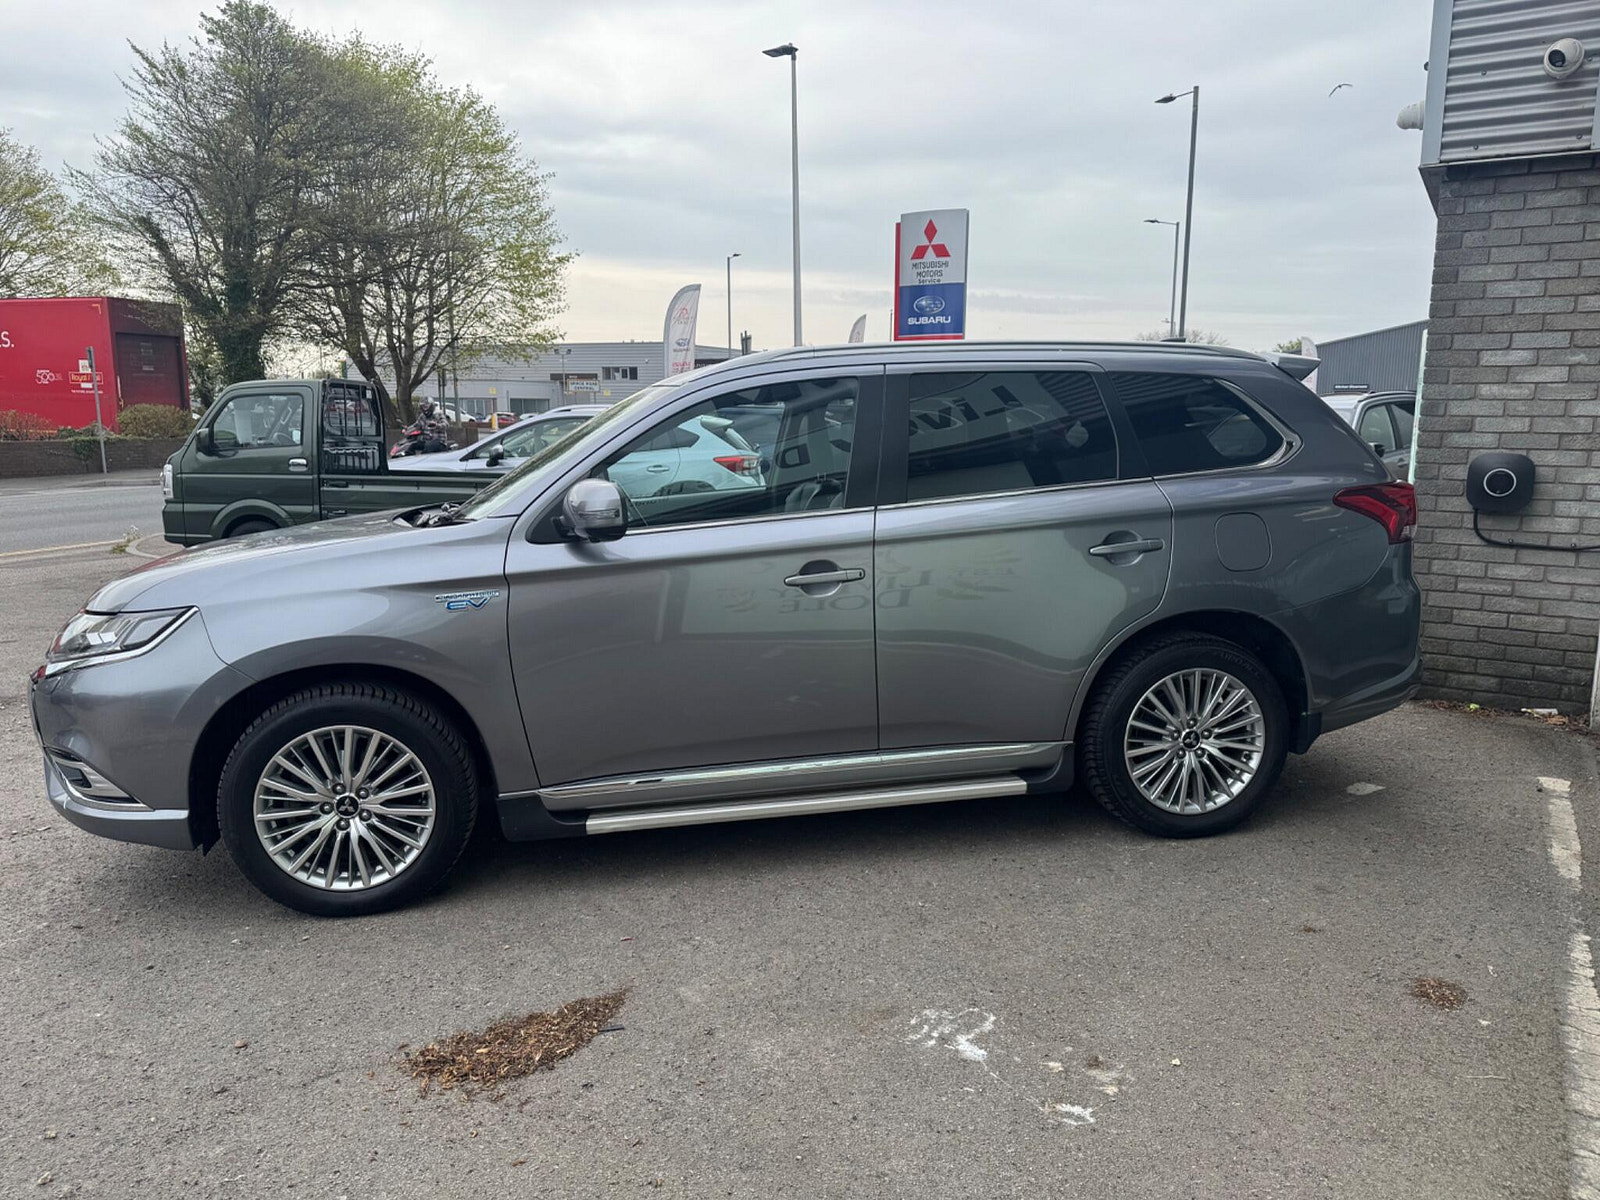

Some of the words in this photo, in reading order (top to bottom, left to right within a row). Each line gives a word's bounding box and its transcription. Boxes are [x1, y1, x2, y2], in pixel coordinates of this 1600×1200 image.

[911, 260, 950, 270] MITSUBISHI
[916, 269, 944, 279] MOTORS
[907, 315, 952, 325] SUBARU
[0, 331, 15, 348] S.
